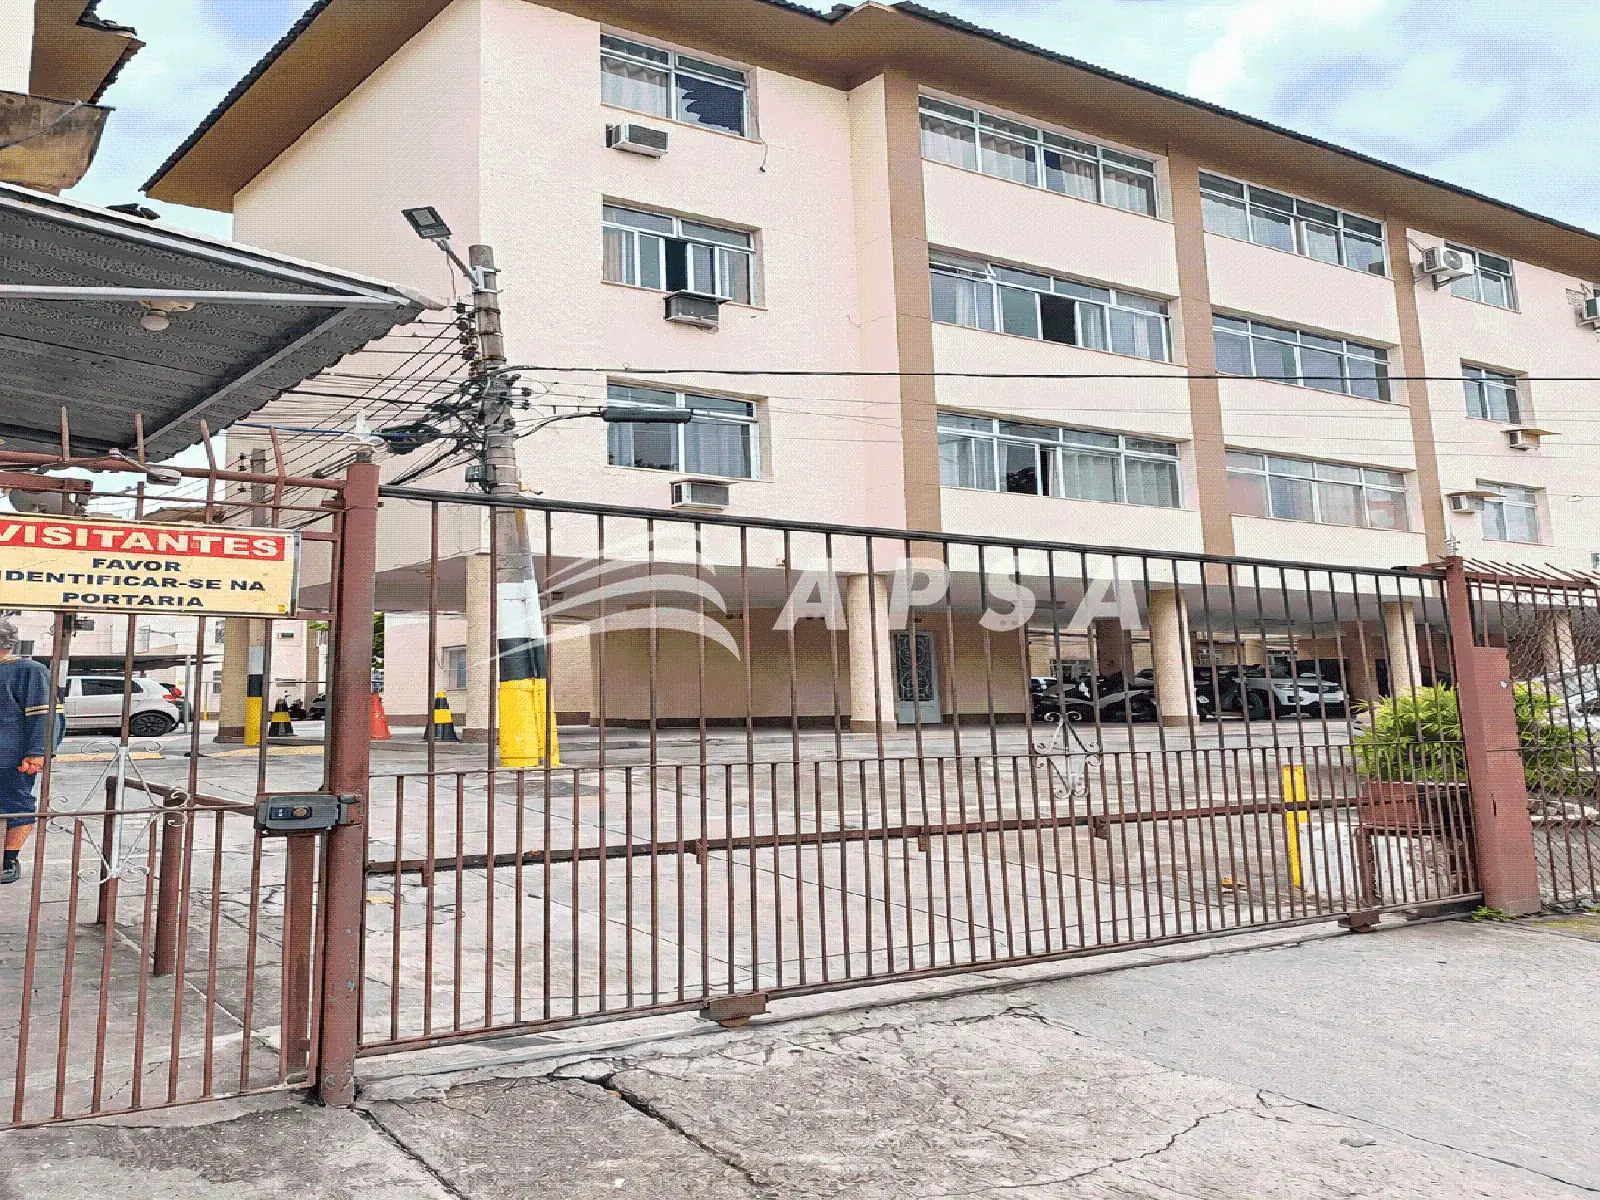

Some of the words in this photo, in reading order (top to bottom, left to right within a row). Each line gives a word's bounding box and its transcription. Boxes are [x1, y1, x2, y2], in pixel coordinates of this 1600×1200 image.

[0, 524, 279, 557] VISITANTES
[92, 557, 181, 572] FAVOR
[0, 570, 221, 590] DENTIFICAR-SE
[230, 579, 266, 591] NA
[62, 591, 204, 607] PORTARIA
